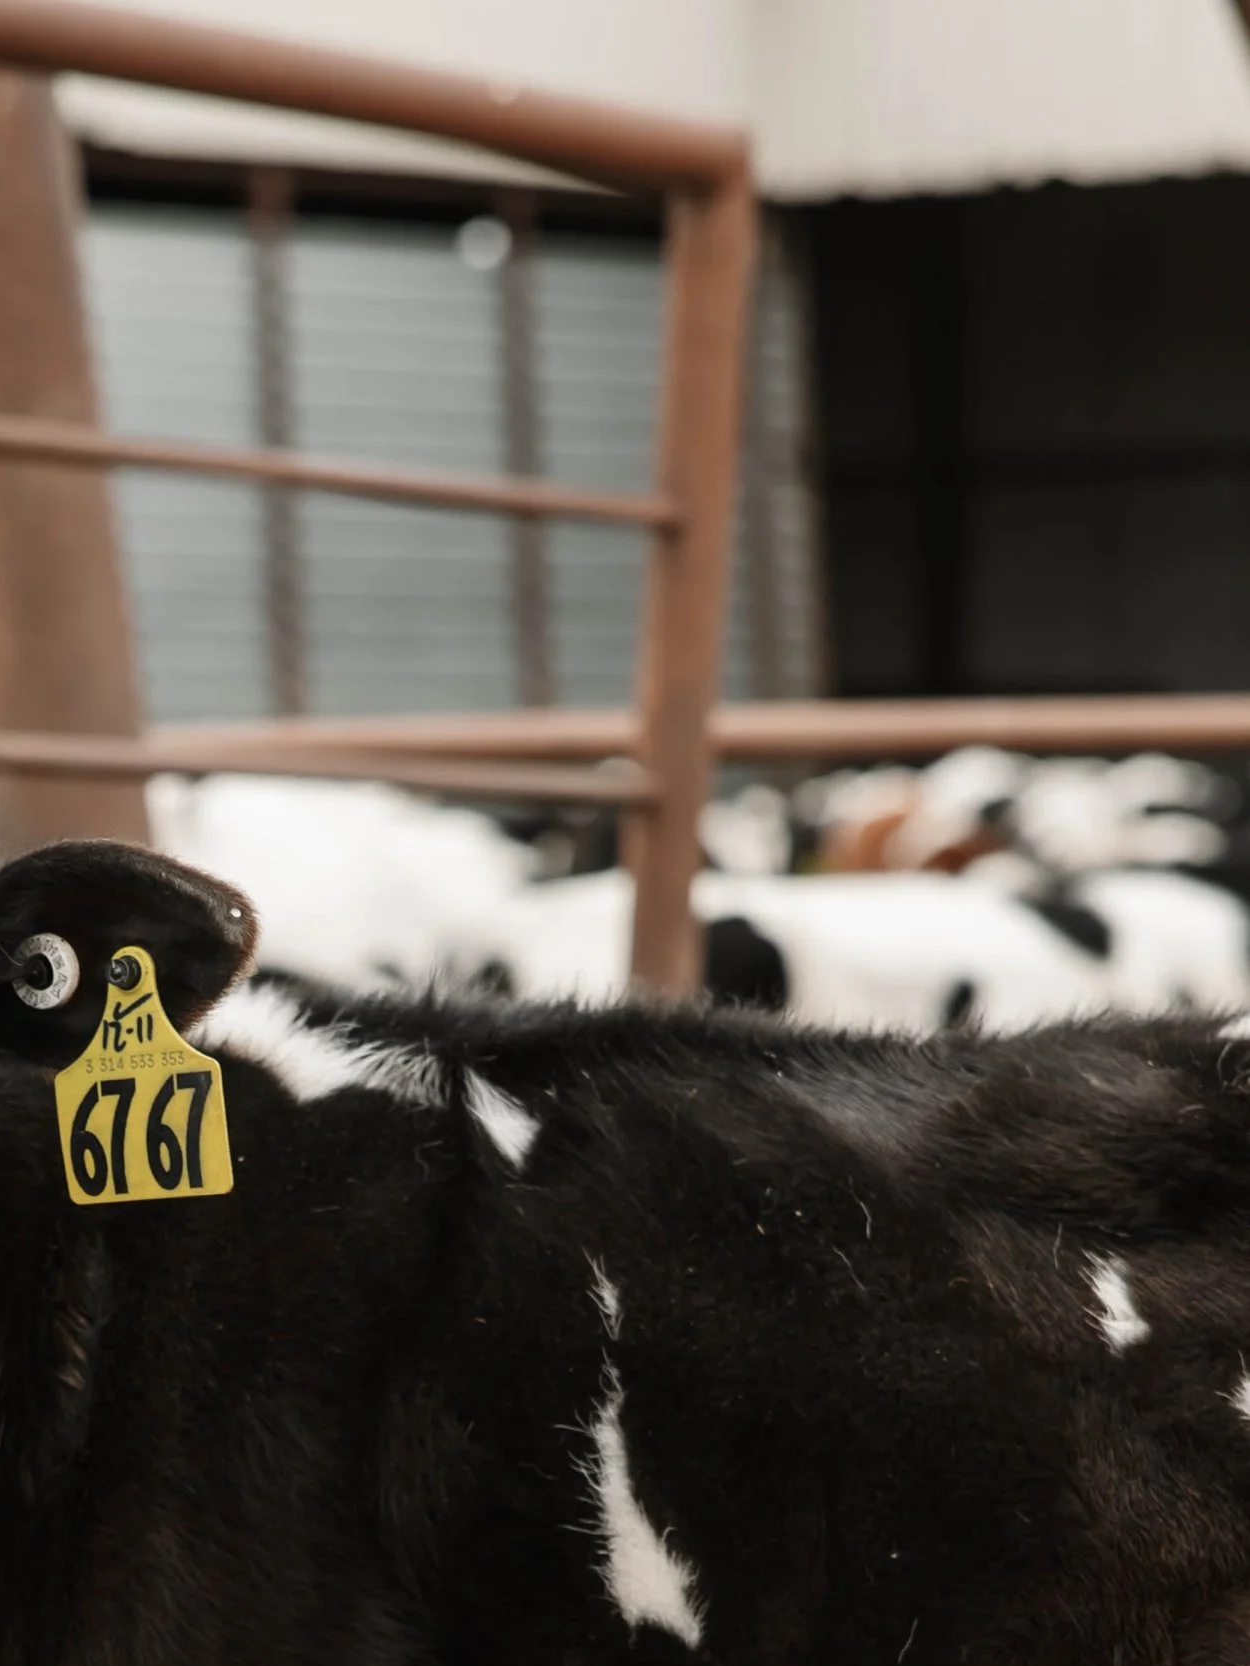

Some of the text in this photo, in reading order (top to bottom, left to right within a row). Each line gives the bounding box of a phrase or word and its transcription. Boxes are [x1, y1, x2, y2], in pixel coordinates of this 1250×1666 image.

[85, 1051, 186, 1074] 3 314 533 353
